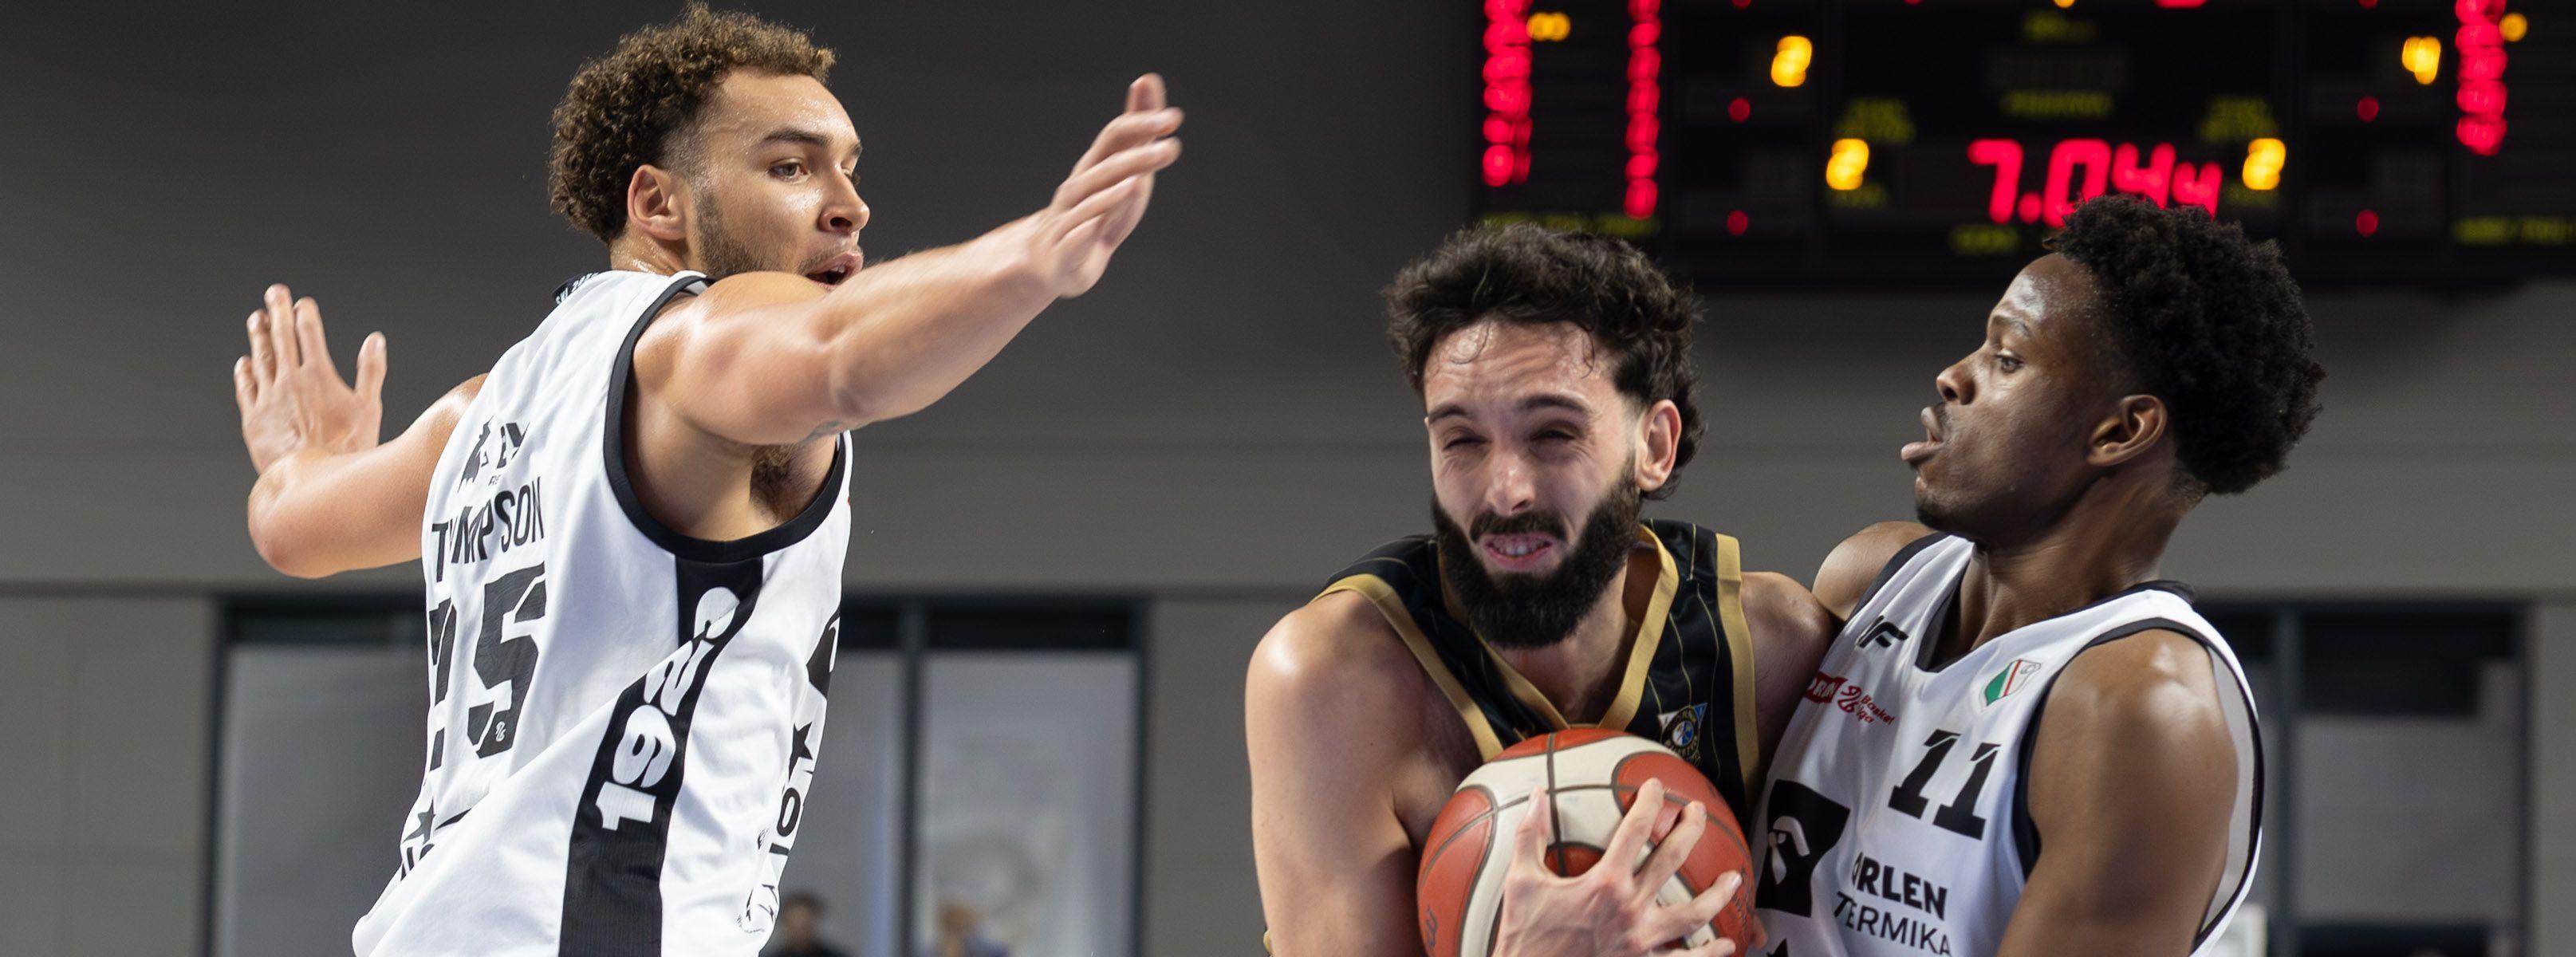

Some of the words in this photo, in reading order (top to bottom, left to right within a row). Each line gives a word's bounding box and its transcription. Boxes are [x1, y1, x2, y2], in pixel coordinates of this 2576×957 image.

[1888, 729, 2003, 840] 11
[1852, 851, 1948, 921] ORLEN
[1833, 890, 1952, 957] TERMIKA
